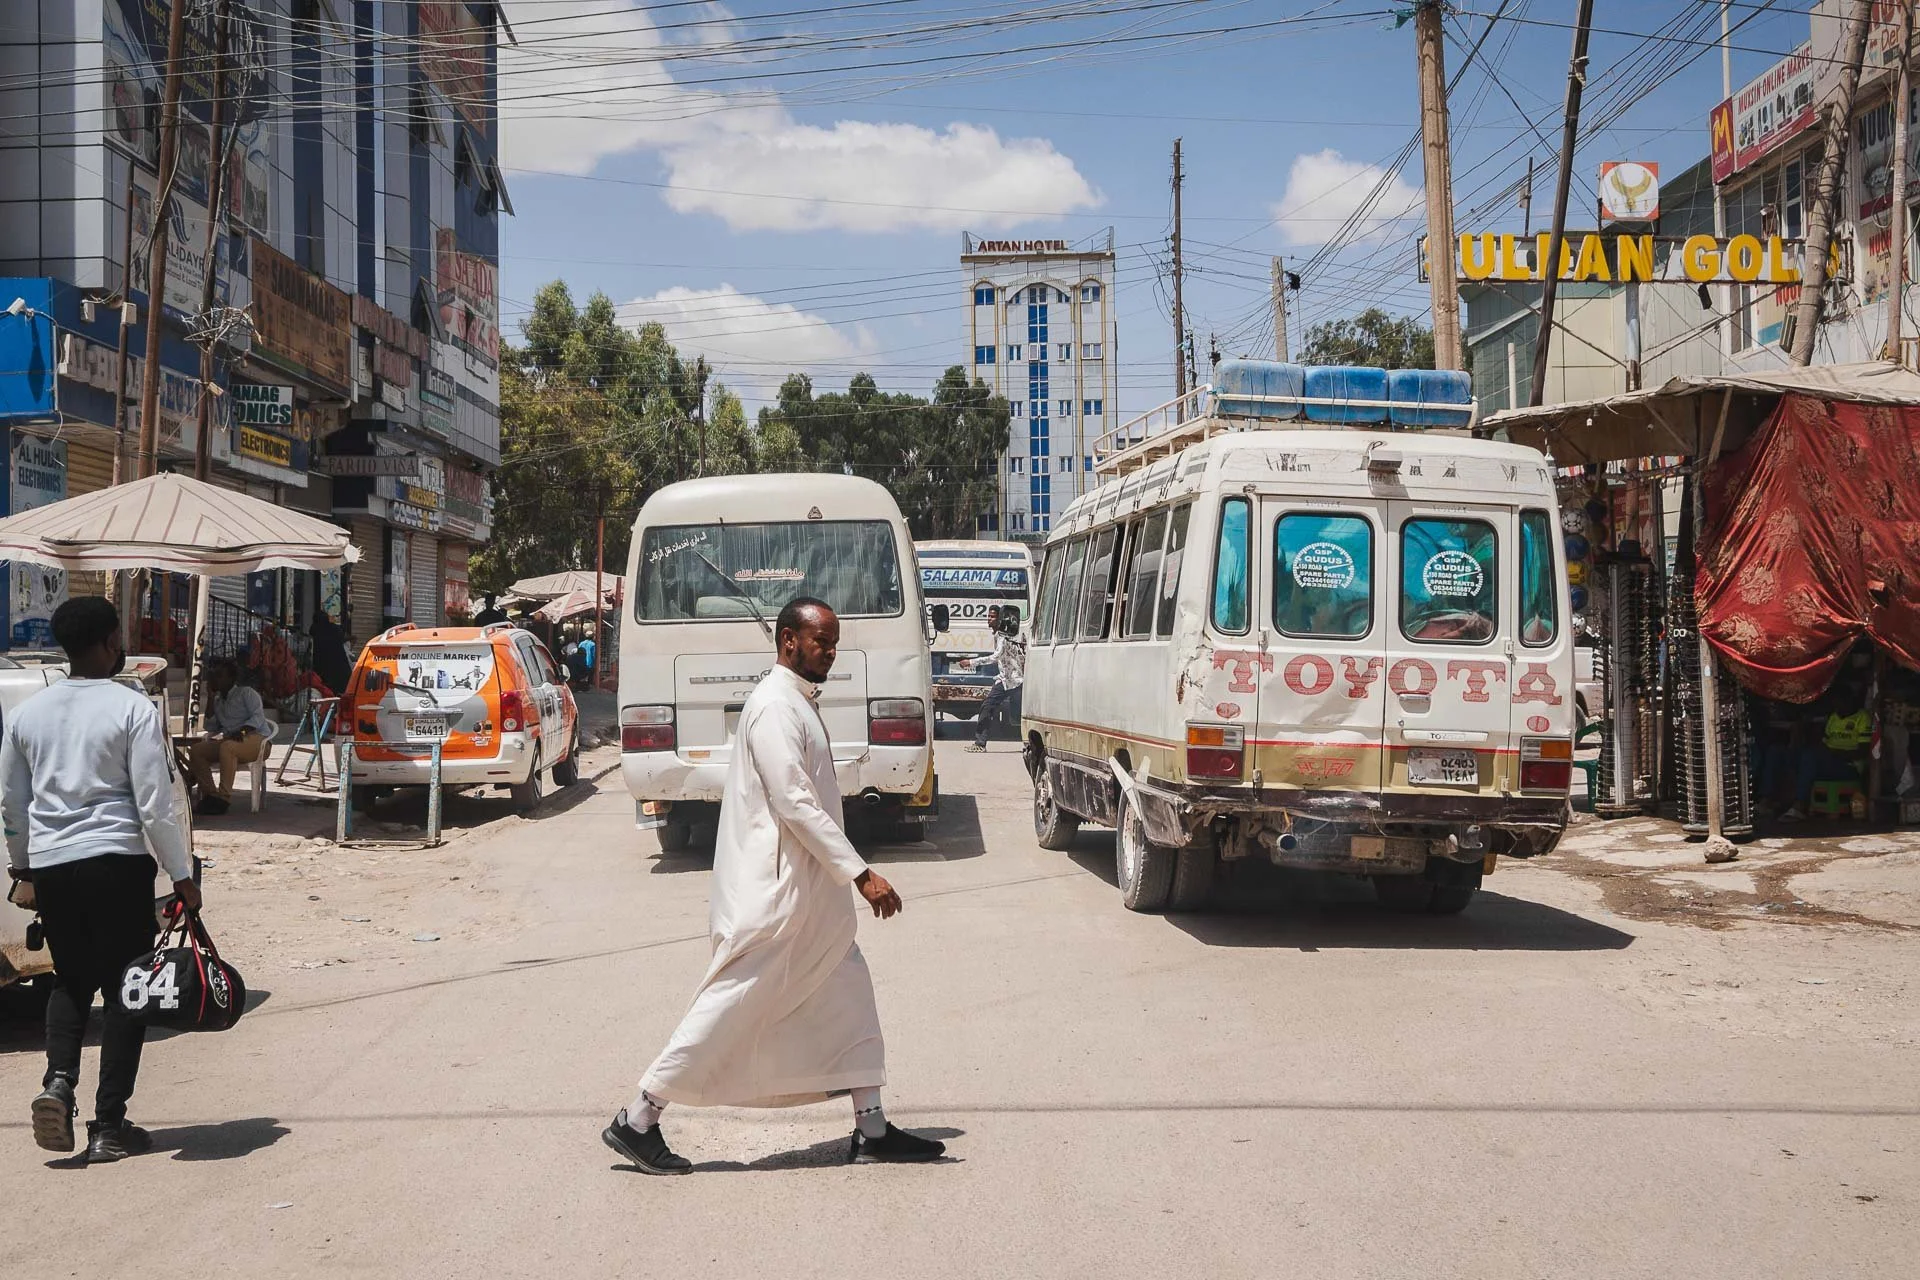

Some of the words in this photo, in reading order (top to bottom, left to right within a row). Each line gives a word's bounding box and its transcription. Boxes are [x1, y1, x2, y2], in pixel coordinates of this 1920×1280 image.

[1762, 63, 1785, 97] ONLINE
[978, 240, 1021, 252] ARTAN
[1024, 239, 1068, 251] HOTEL
[1423, 231, 1654, 282] ULDAN
[18, 444, 32, 463] AL
[241, 431, 290, 462] ELECTRONICS
[383, 458, 415, 474] VISA
[18, 468, 61, 494] ELECTRONICS
[1304, 555, 1343, 565] QUDUS
[1434, 564, 1472, 572] QUDUS
[922, 570, 992, 582] SALAAMA
[1002, 571, 1019, 584] 48
[950, 604, 988, 618] 202
[443, 653, 482, 662] MARKET
[1213, 649, 1563, 706] TOYOTA
[122, 962, 180, 1010] 84
